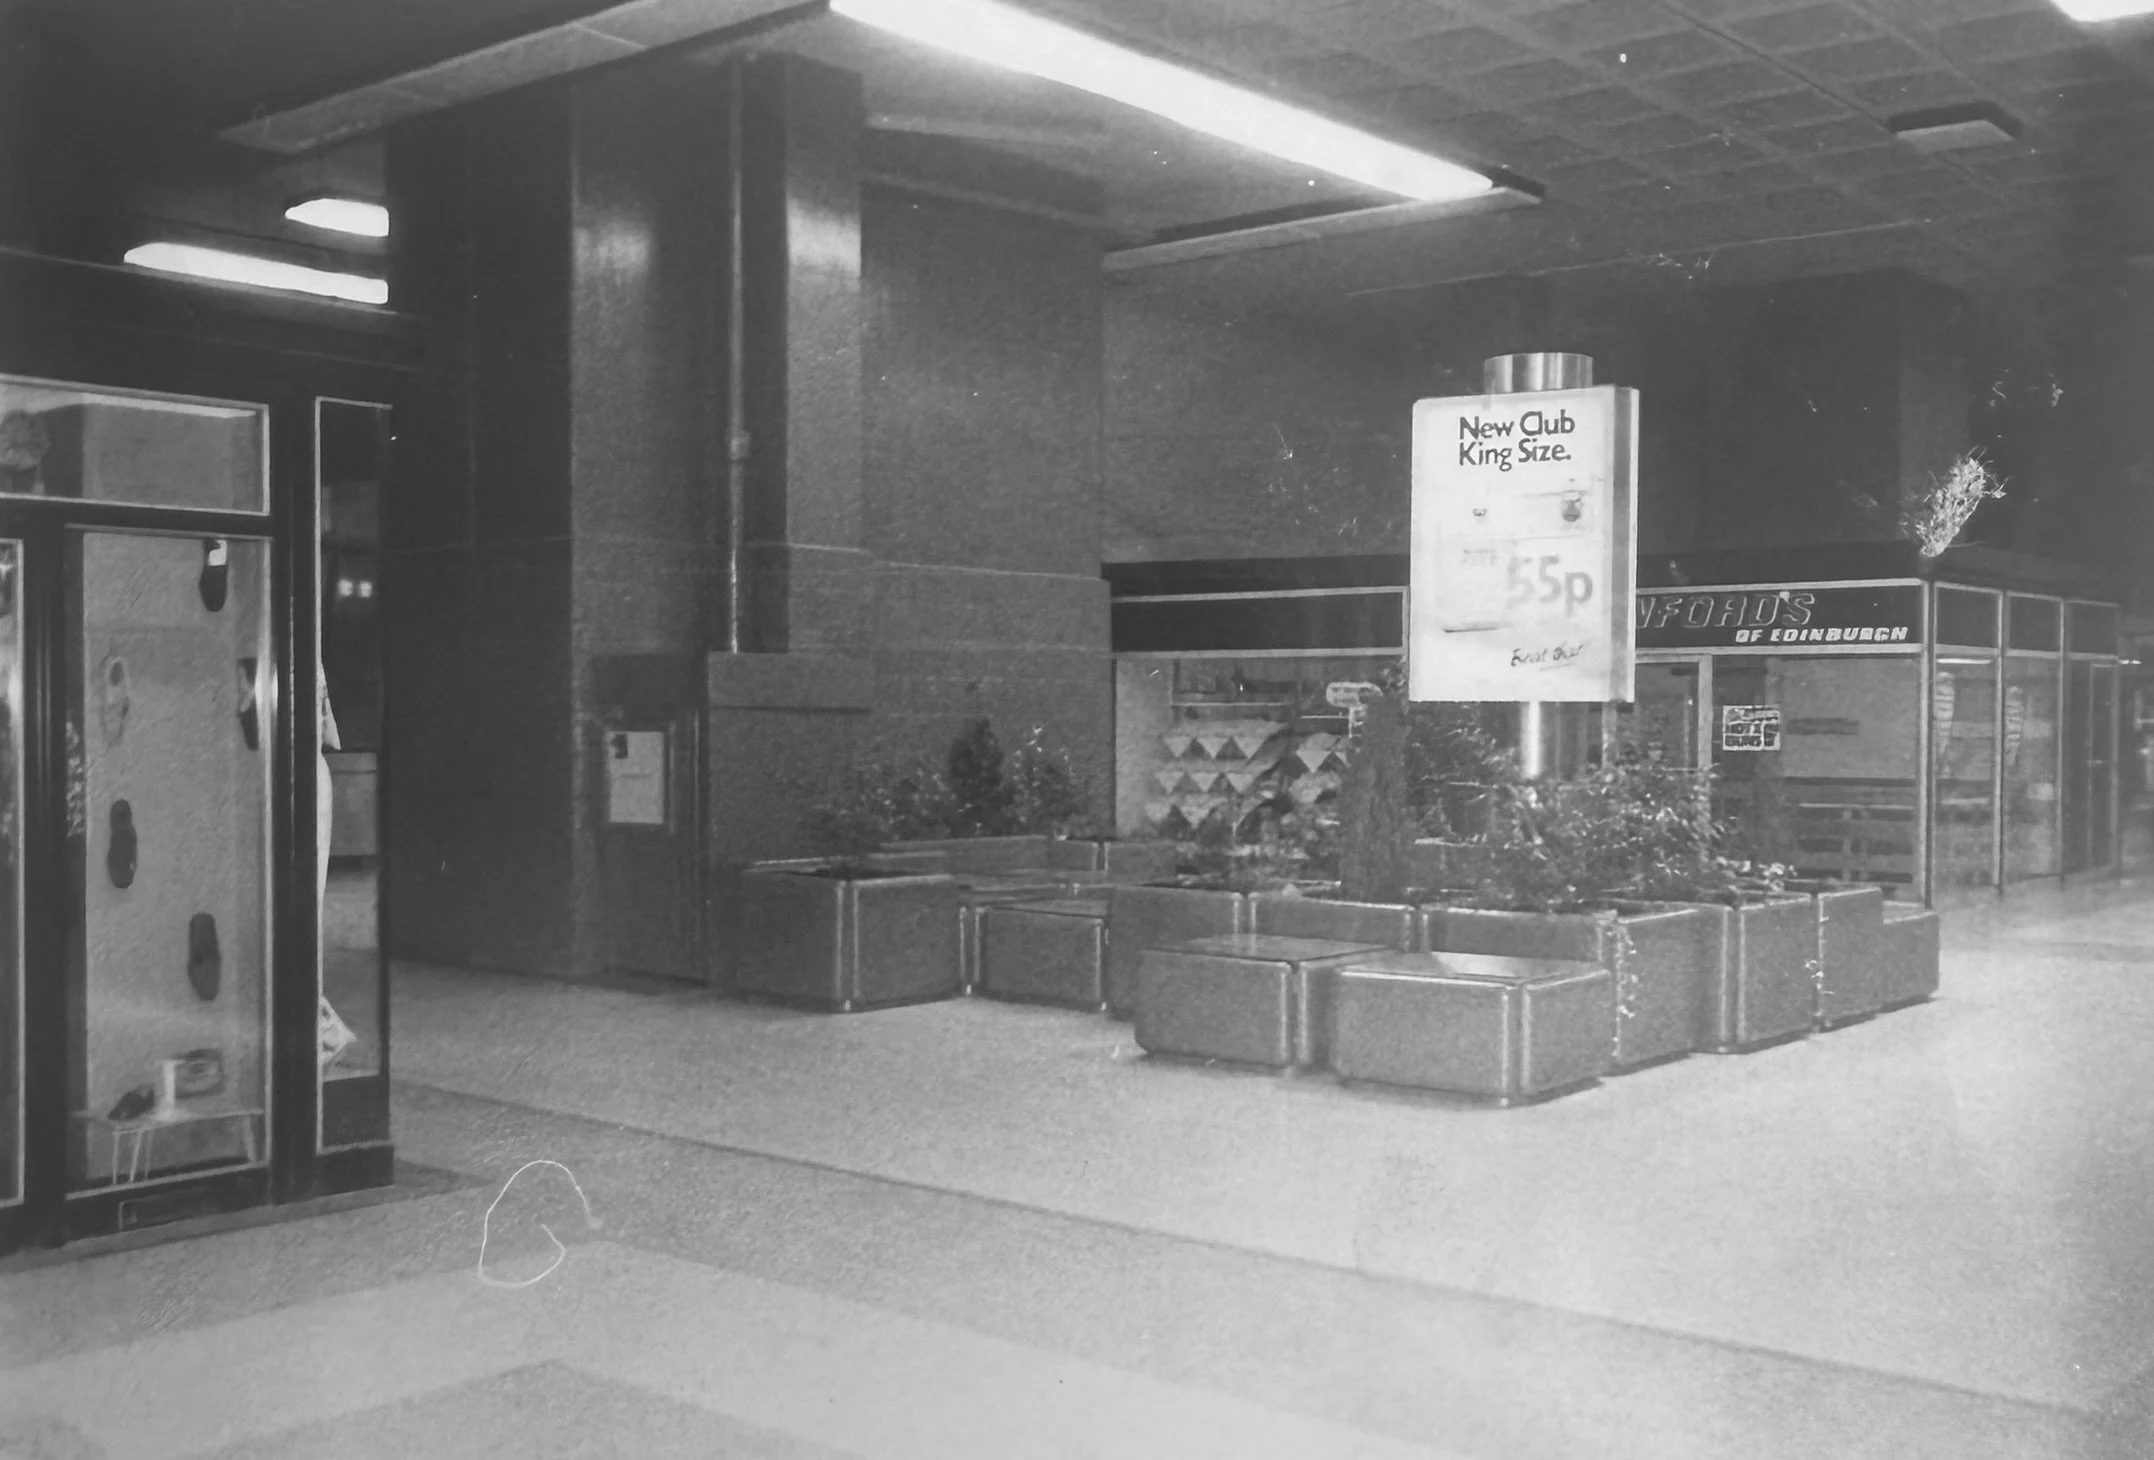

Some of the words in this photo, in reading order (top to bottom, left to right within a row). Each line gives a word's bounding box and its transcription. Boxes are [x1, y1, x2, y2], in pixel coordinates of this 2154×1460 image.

[1459, 415, 1514, 440] New
[1519, 409, 1576, 436] Club
[1459, 441, 1512, 472] King
[1506, 554, 1594, 618] 55p
[1735, 628, 1763, 643] OF
[1769, 626, 1909, 643] EDINBURGH
